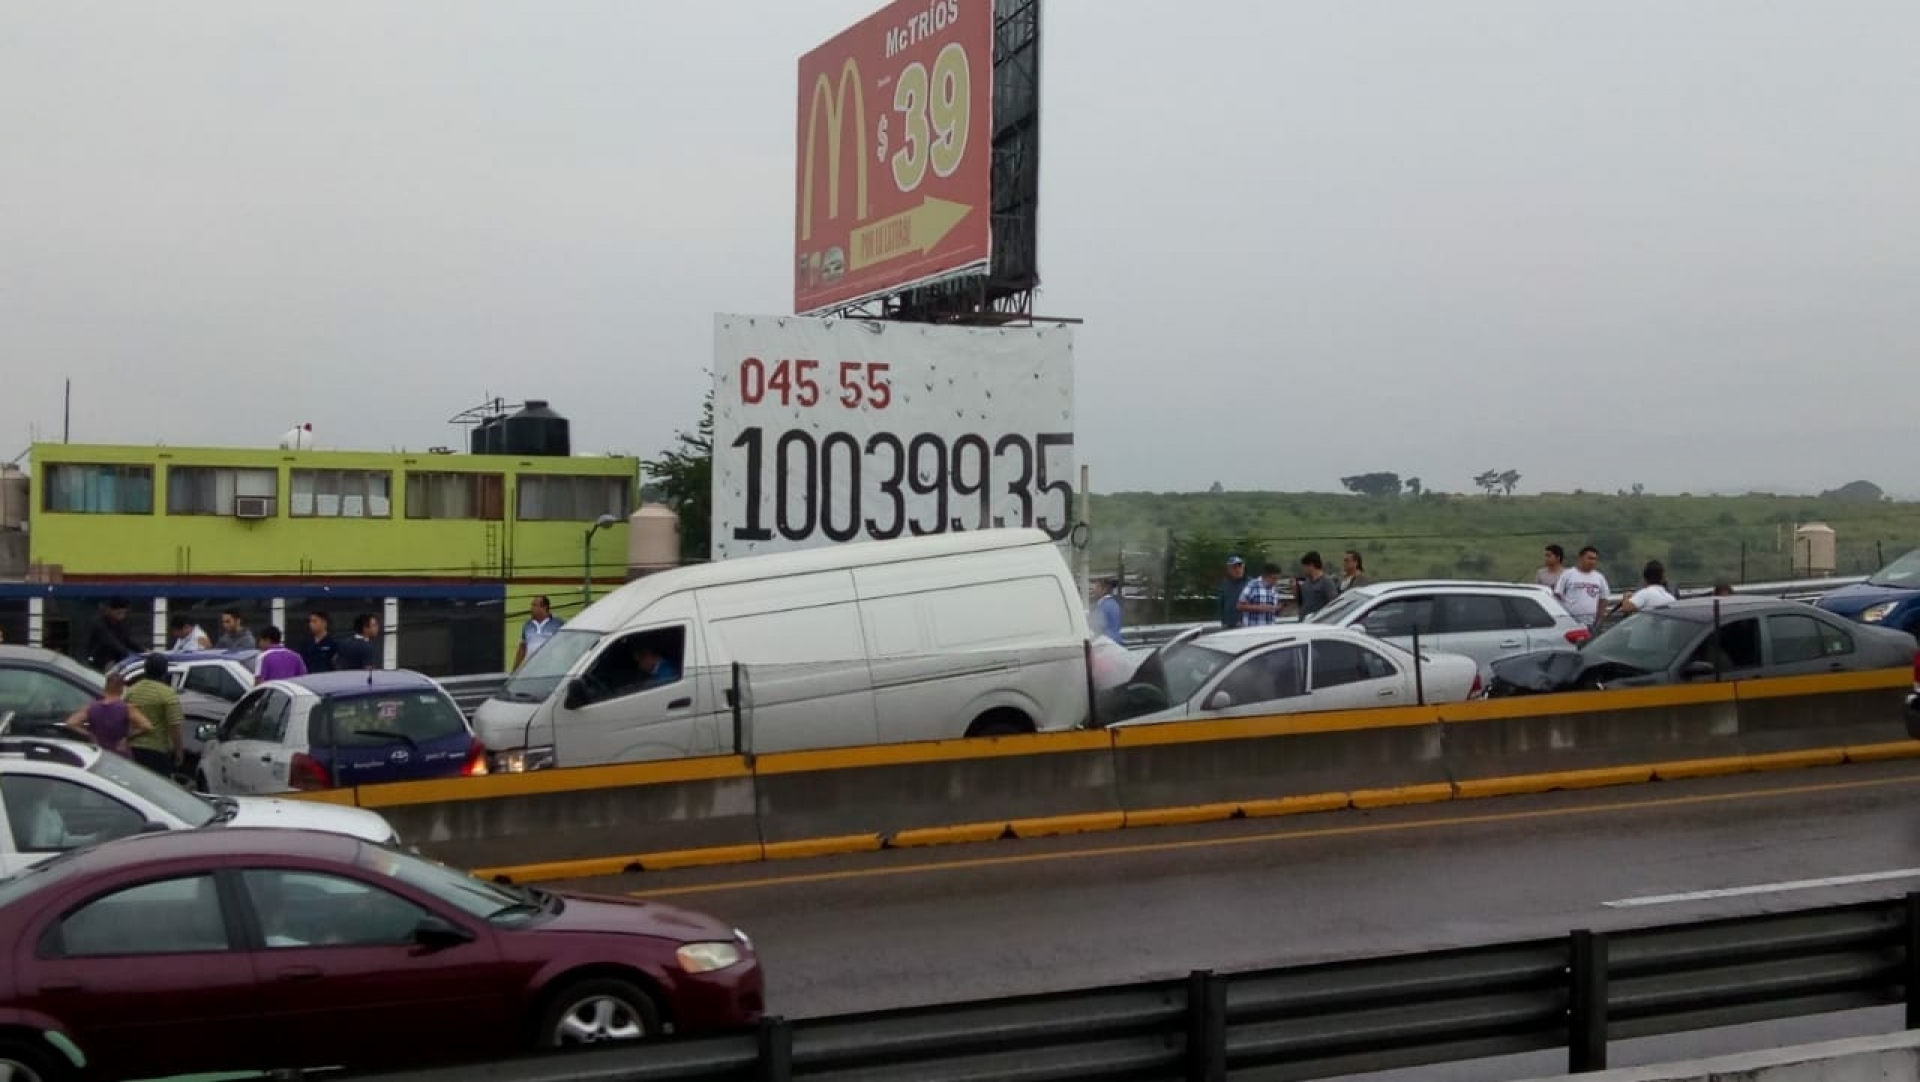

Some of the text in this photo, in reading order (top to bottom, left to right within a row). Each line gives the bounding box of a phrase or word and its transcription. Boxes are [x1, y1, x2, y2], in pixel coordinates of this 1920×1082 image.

[739, 357, 891, 409] 045 55
[731, 426, 1075, 542] 10039935
